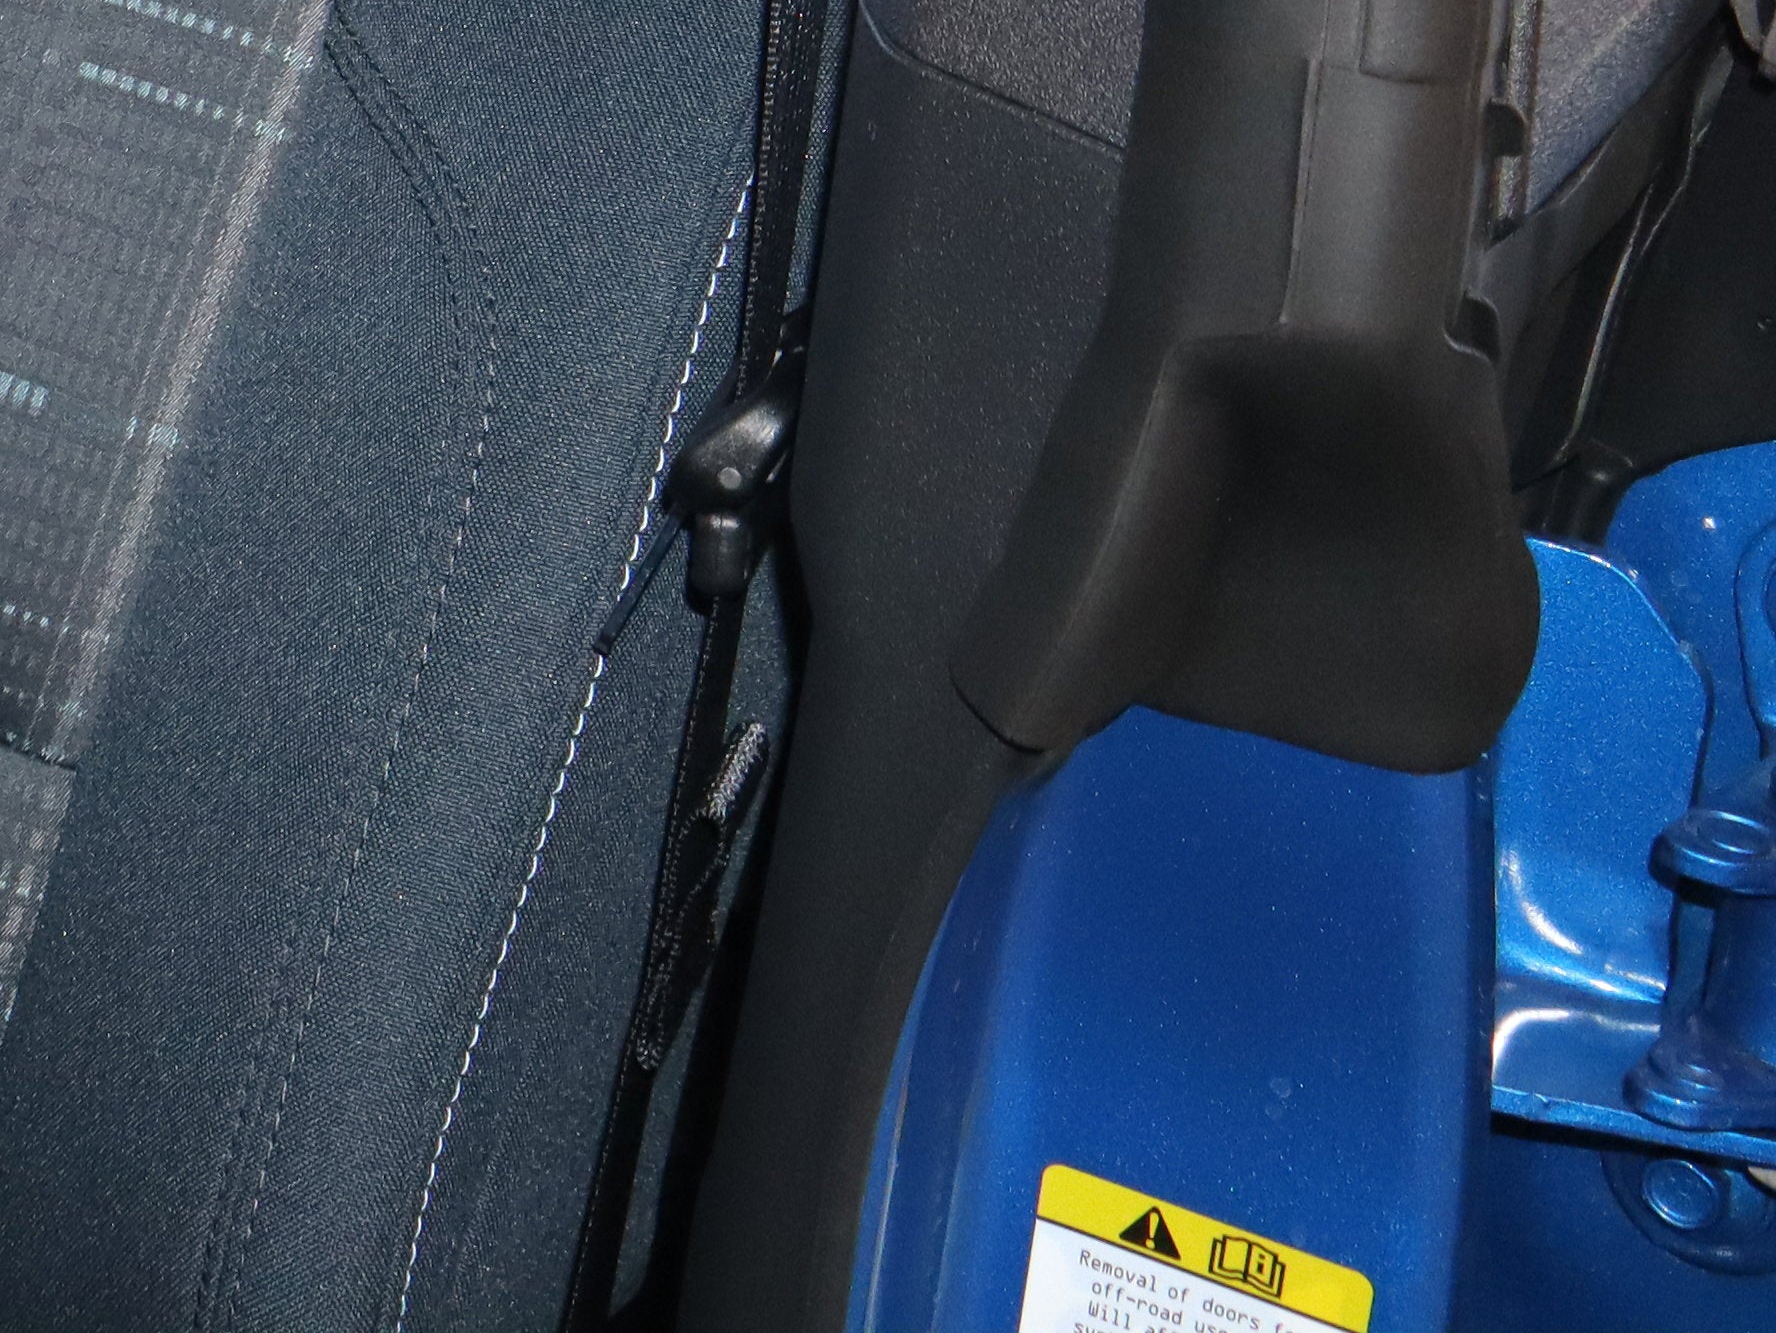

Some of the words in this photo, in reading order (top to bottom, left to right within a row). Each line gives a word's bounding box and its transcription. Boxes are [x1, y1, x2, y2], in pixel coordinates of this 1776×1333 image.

[1079, 1249, 1157, 1293] Removal
[1168, 1286, 1189, 1303] of
[1202, 1297, 1260, 1331] doors
[1088, 1300, 1131, 1331] Will
[1091, 1281, 1184, 1326] off-road
[1194, 1319, 1228, 1333] us
